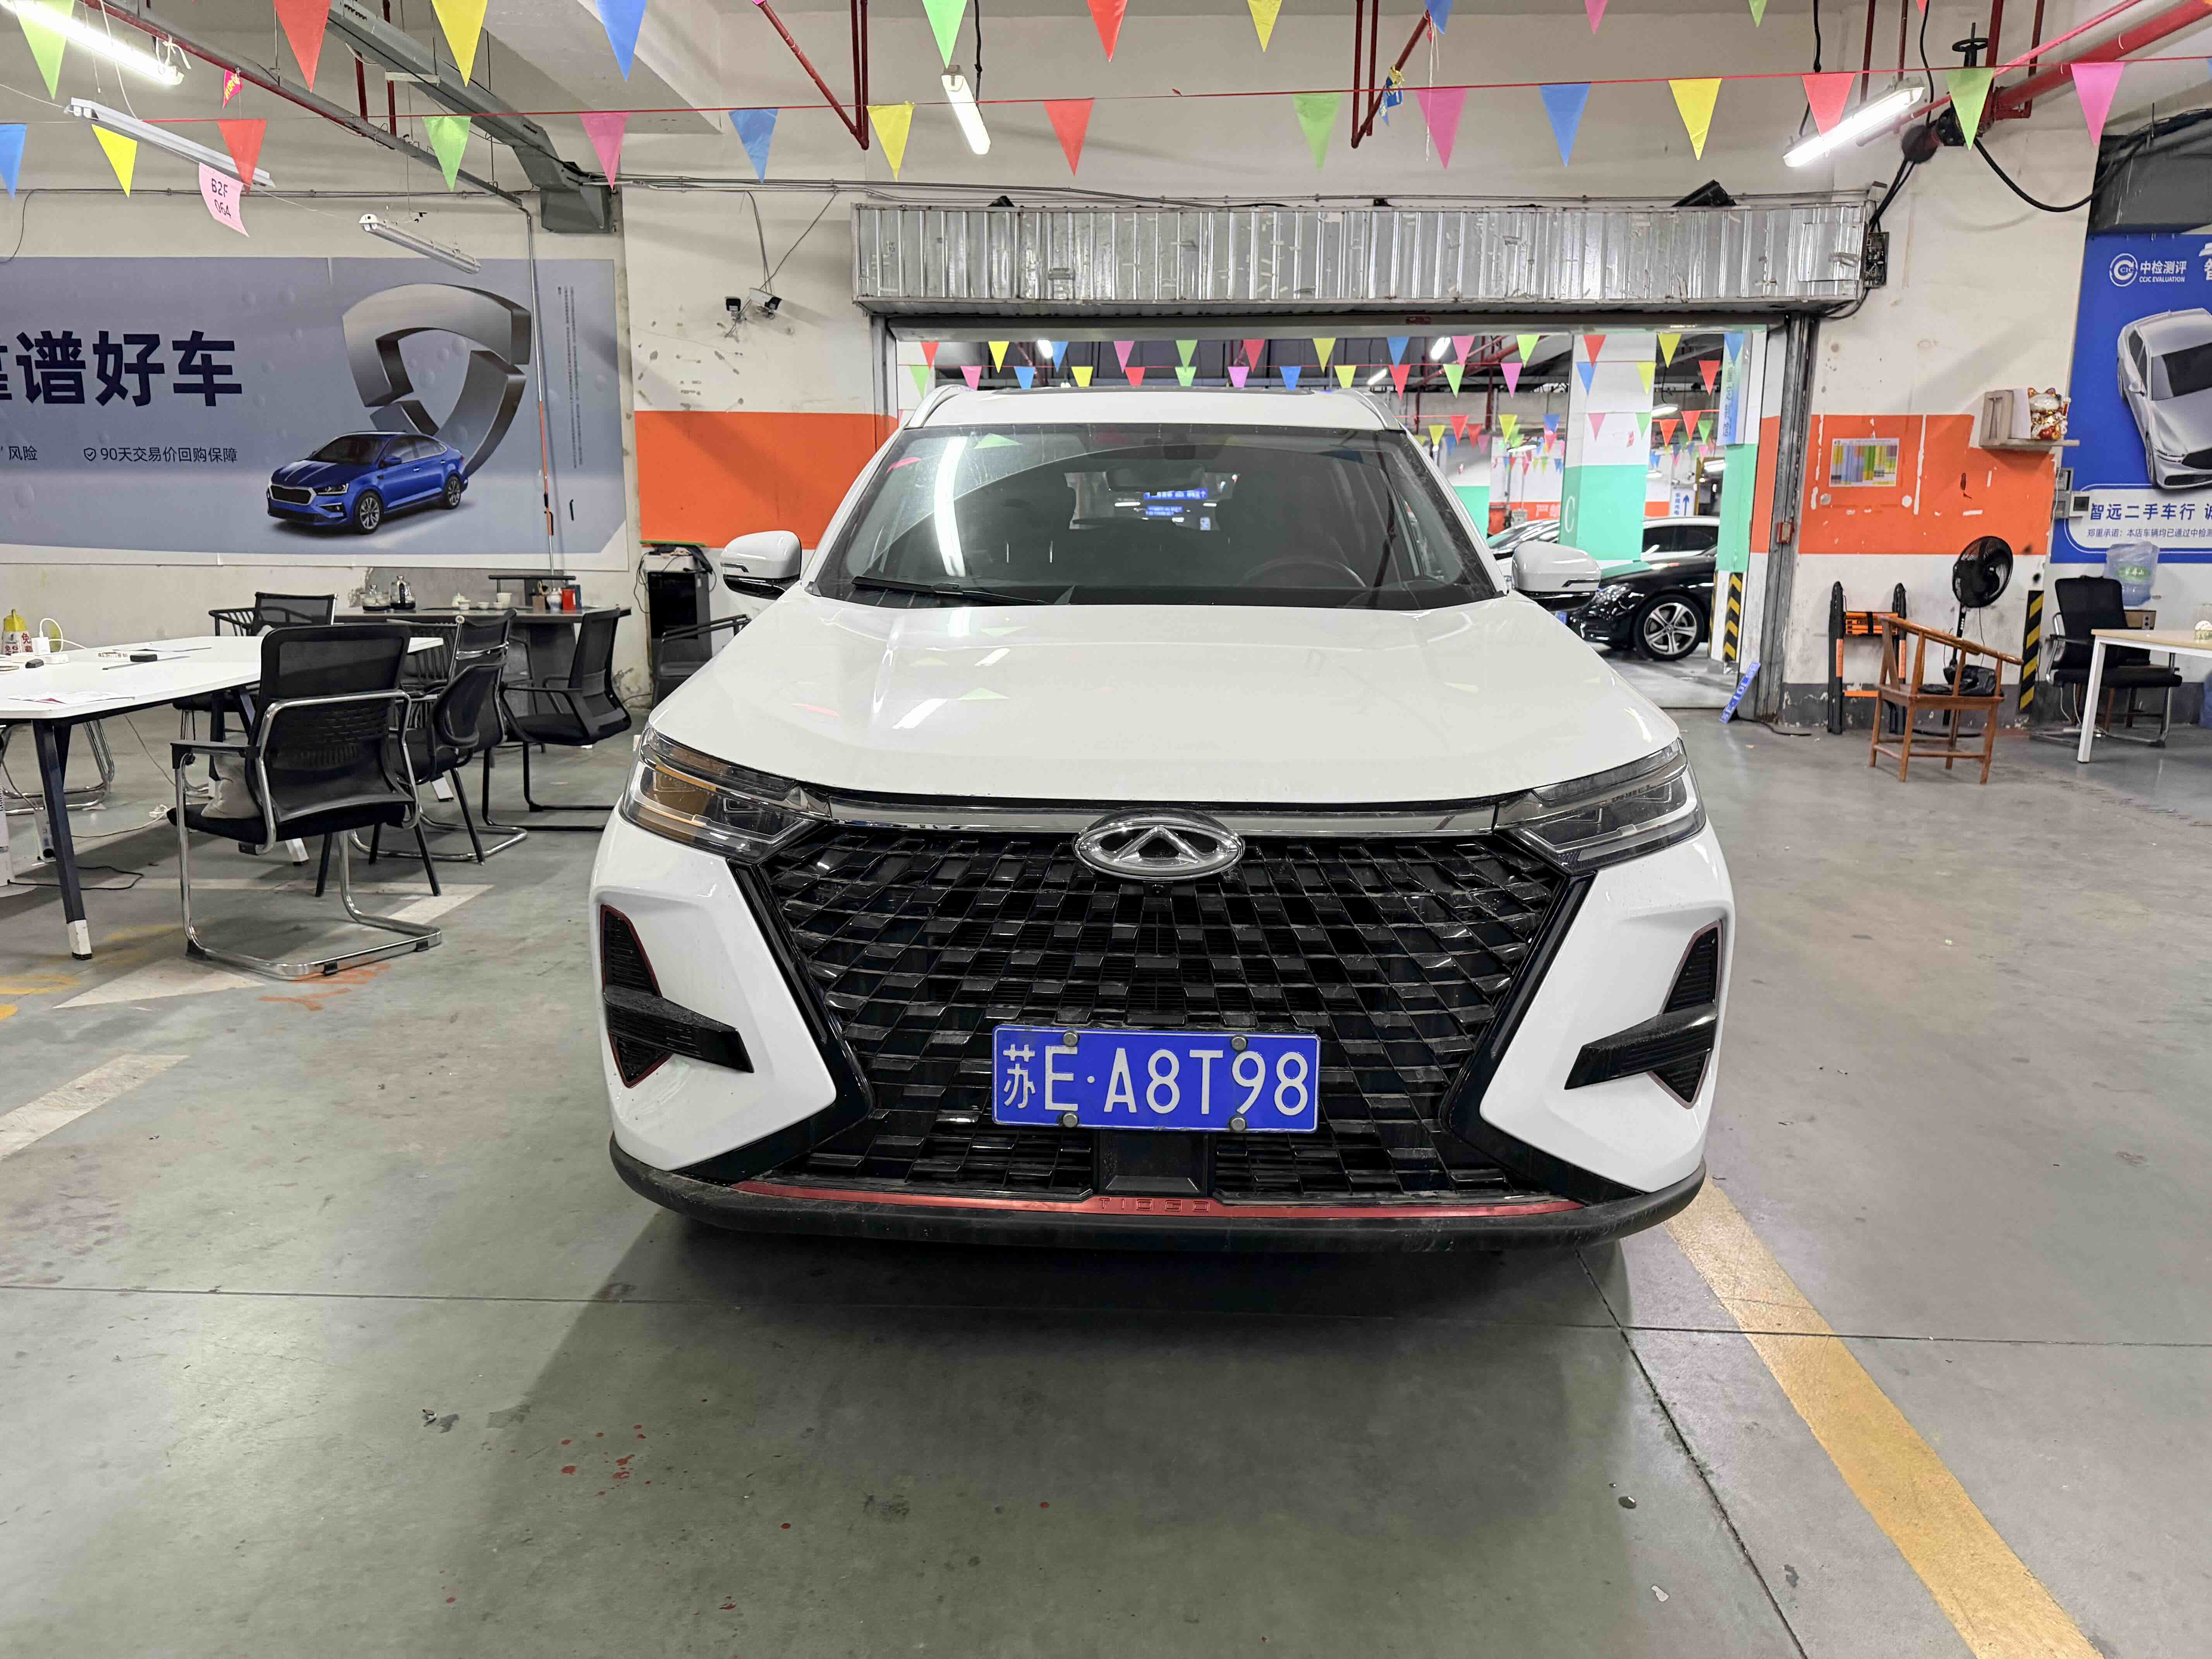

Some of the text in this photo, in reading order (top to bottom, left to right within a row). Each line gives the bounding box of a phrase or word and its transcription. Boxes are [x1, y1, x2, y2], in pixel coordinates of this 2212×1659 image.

[211, 178, 228, 198] B2F
[2140, 260, 2187, 275] 中检测评
[9, 446, 38, 460] 风险
[100, 447, 238, 463] 90天交易价回购保障
[2090, 503, 2195, 520] 智远二手车行
[1003, 1044, 1308, 1116] 苏E·A8T98
